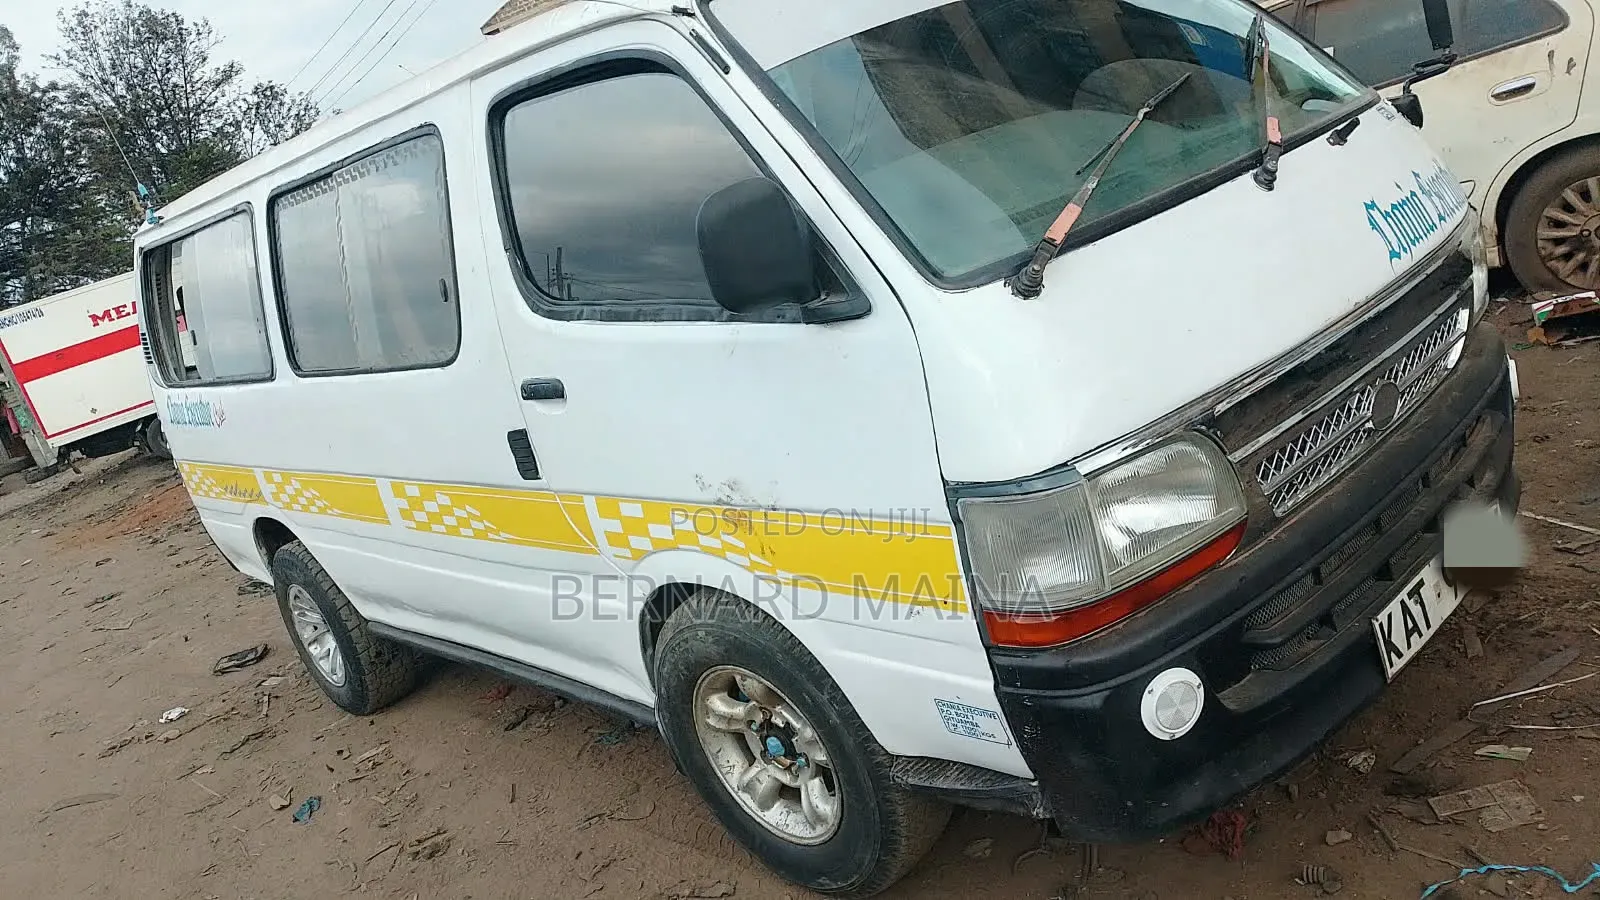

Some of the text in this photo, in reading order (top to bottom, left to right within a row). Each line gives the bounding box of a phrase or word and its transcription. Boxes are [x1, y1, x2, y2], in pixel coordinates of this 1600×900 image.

[1378, 577, 1431, 669] KAT
[937, 701, 998, 720] CHANIA EXECUTIVE
[954, 711, 970, 720] BOX
[943, 715, 981, 728] GITUAMBA
